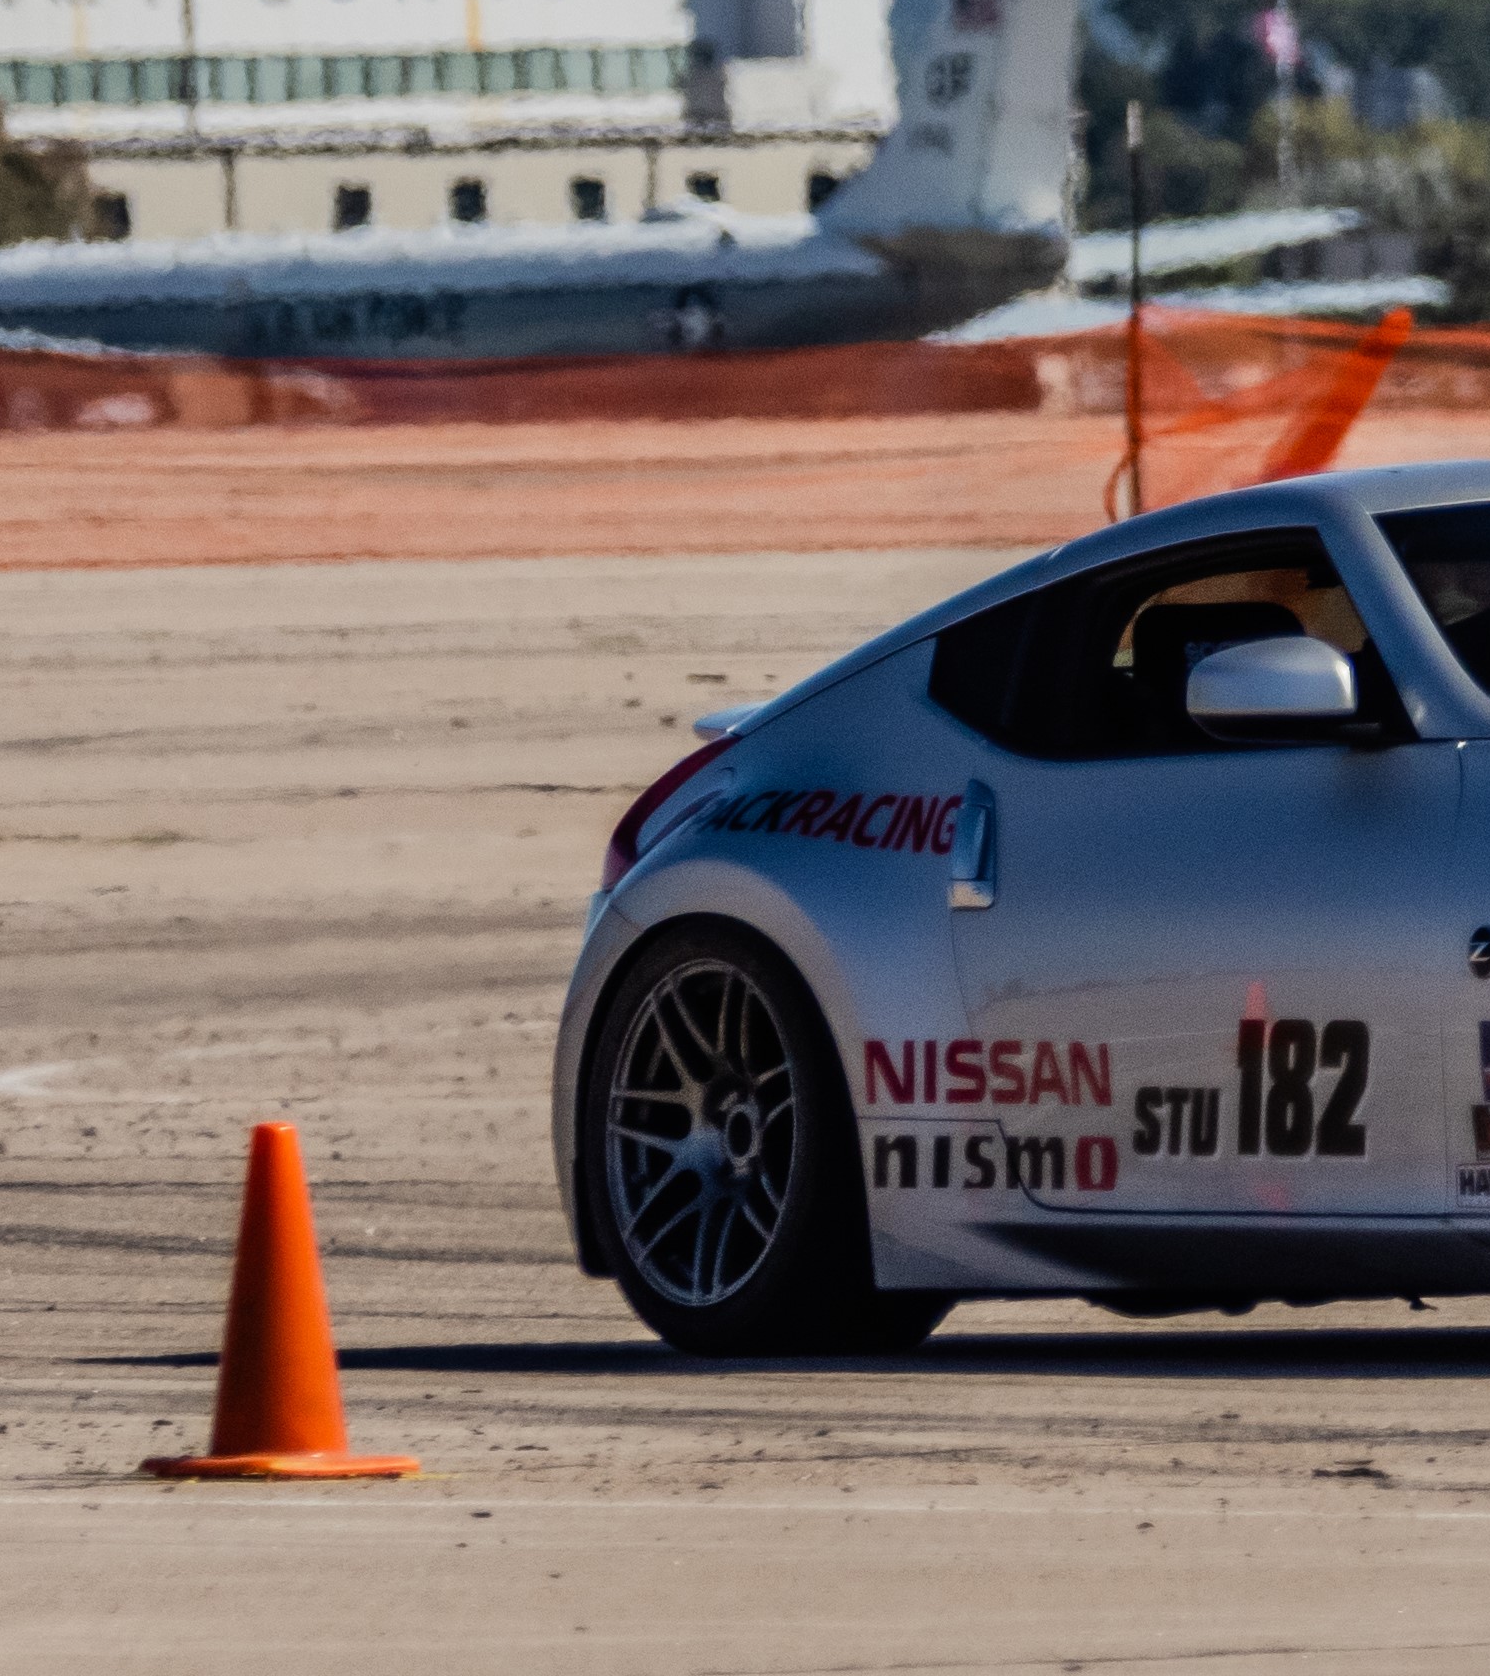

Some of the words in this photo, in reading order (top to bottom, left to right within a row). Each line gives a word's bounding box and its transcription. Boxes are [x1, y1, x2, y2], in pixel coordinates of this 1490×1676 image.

[863, 1039, 1112, 1106] NISSAN
[1132, 1086, 1222, 1157] STU
[1237, 1018, 1372, 1158] 182
[872, 1133, 1119, 1191] nismo
